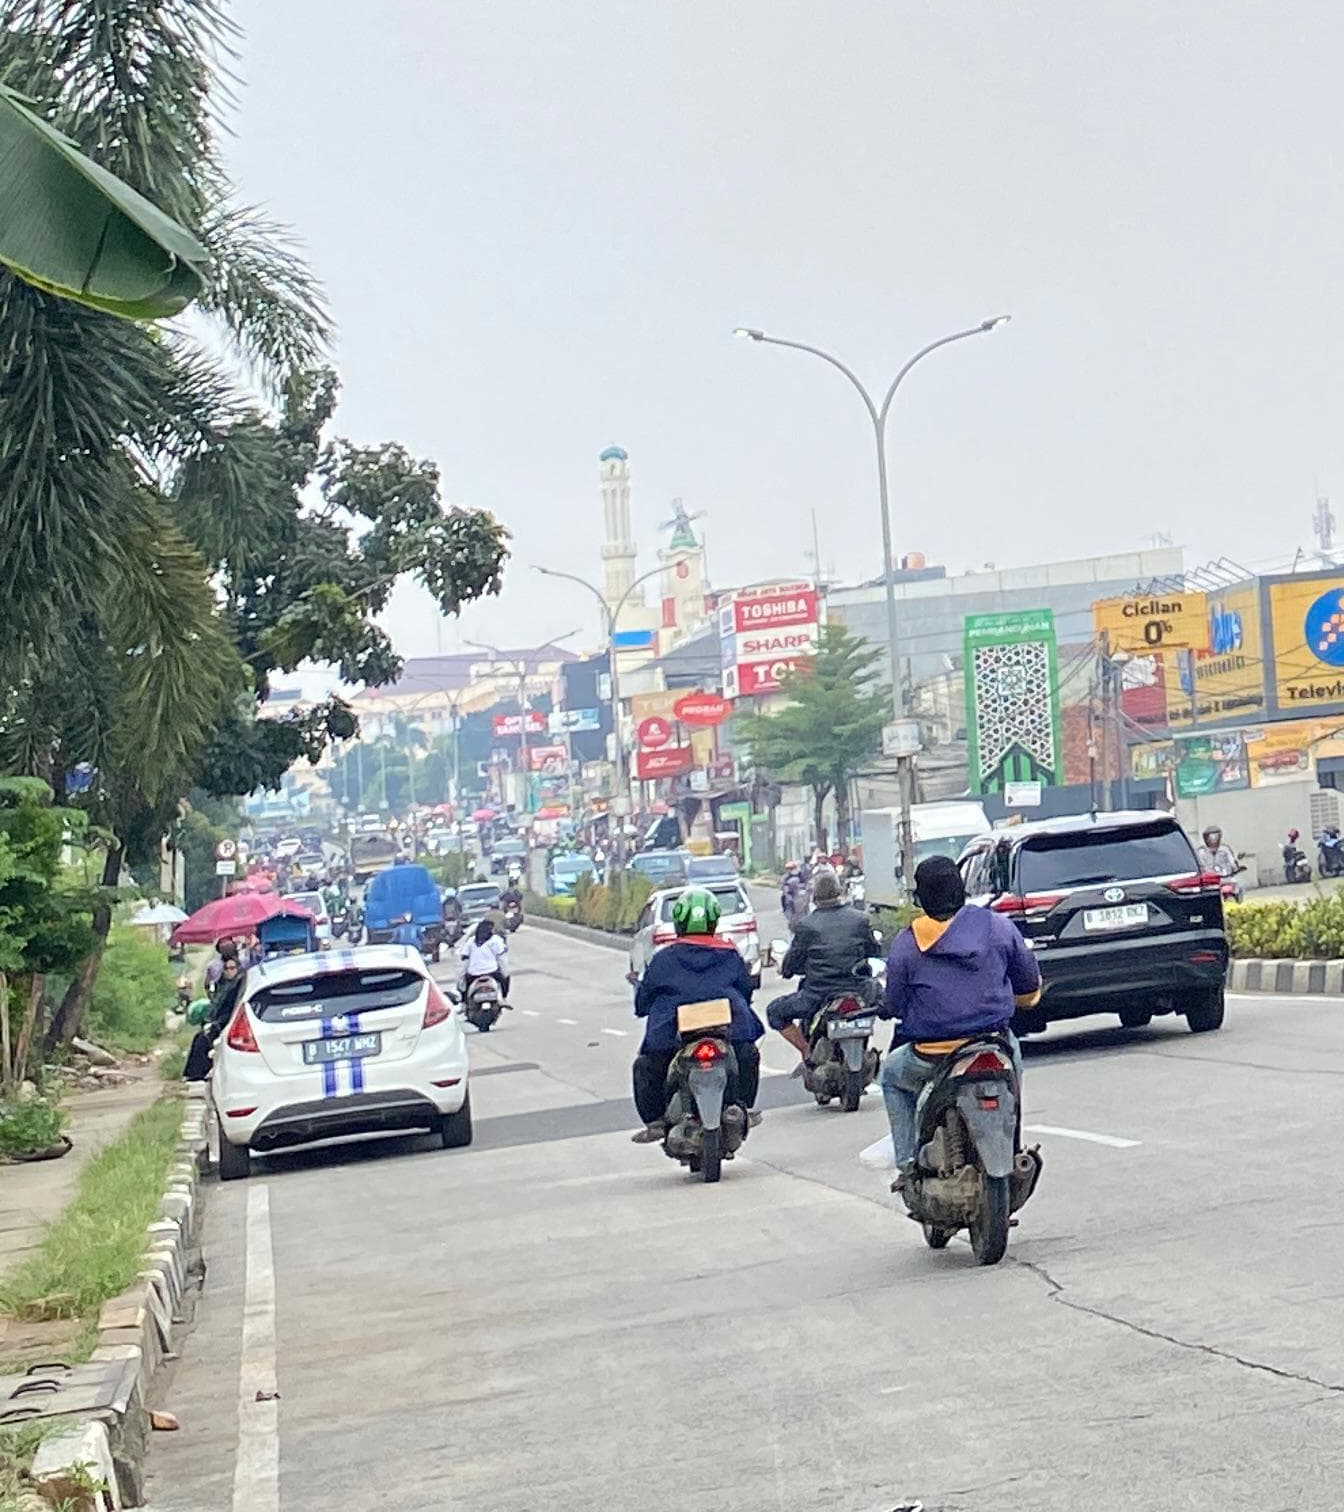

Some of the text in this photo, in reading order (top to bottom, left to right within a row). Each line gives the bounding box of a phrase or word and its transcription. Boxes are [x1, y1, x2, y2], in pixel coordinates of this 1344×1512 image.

[742, 598, 807, 619] TOSHIBA
[1122, 600, 1182, 618] Cicilan
[743, 634, 810, 653] SHARP
[308, 1044, 317, 1057] B
